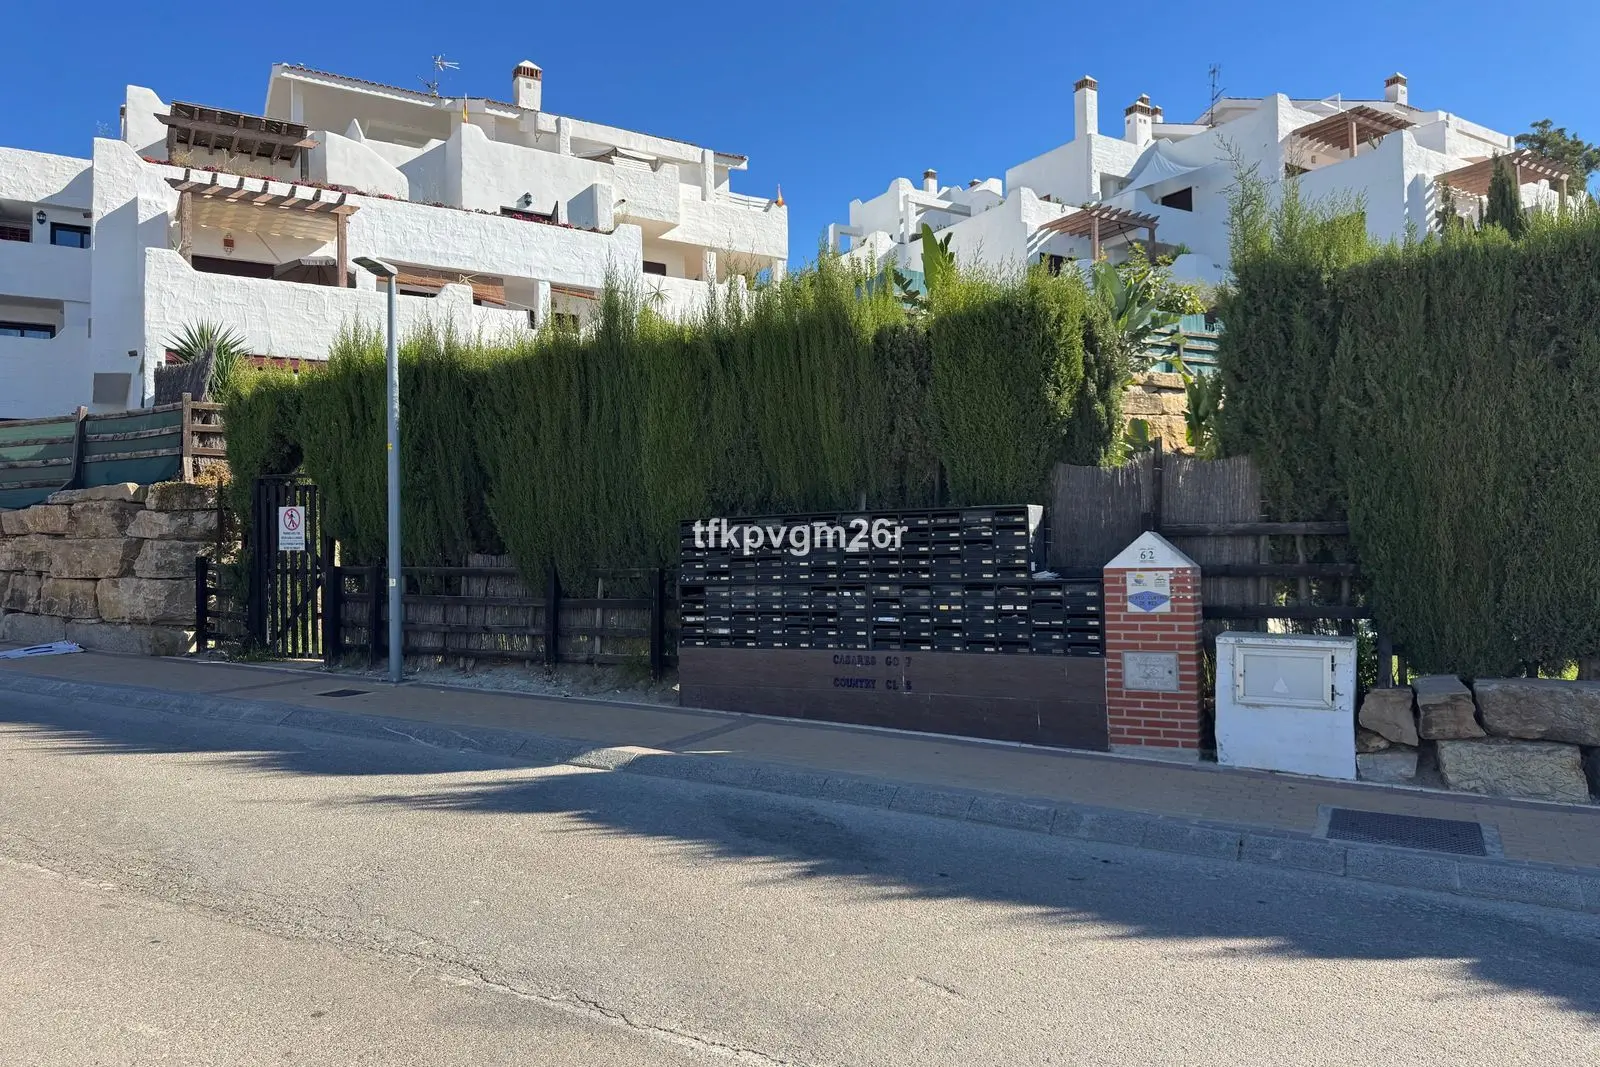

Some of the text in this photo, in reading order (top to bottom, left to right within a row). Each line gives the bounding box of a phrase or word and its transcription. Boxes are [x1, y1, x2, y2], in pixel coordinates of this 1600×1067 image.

[1140, 550, 1155, 560] 62
[833, 677, 912, 690] COUNTRY CLB
